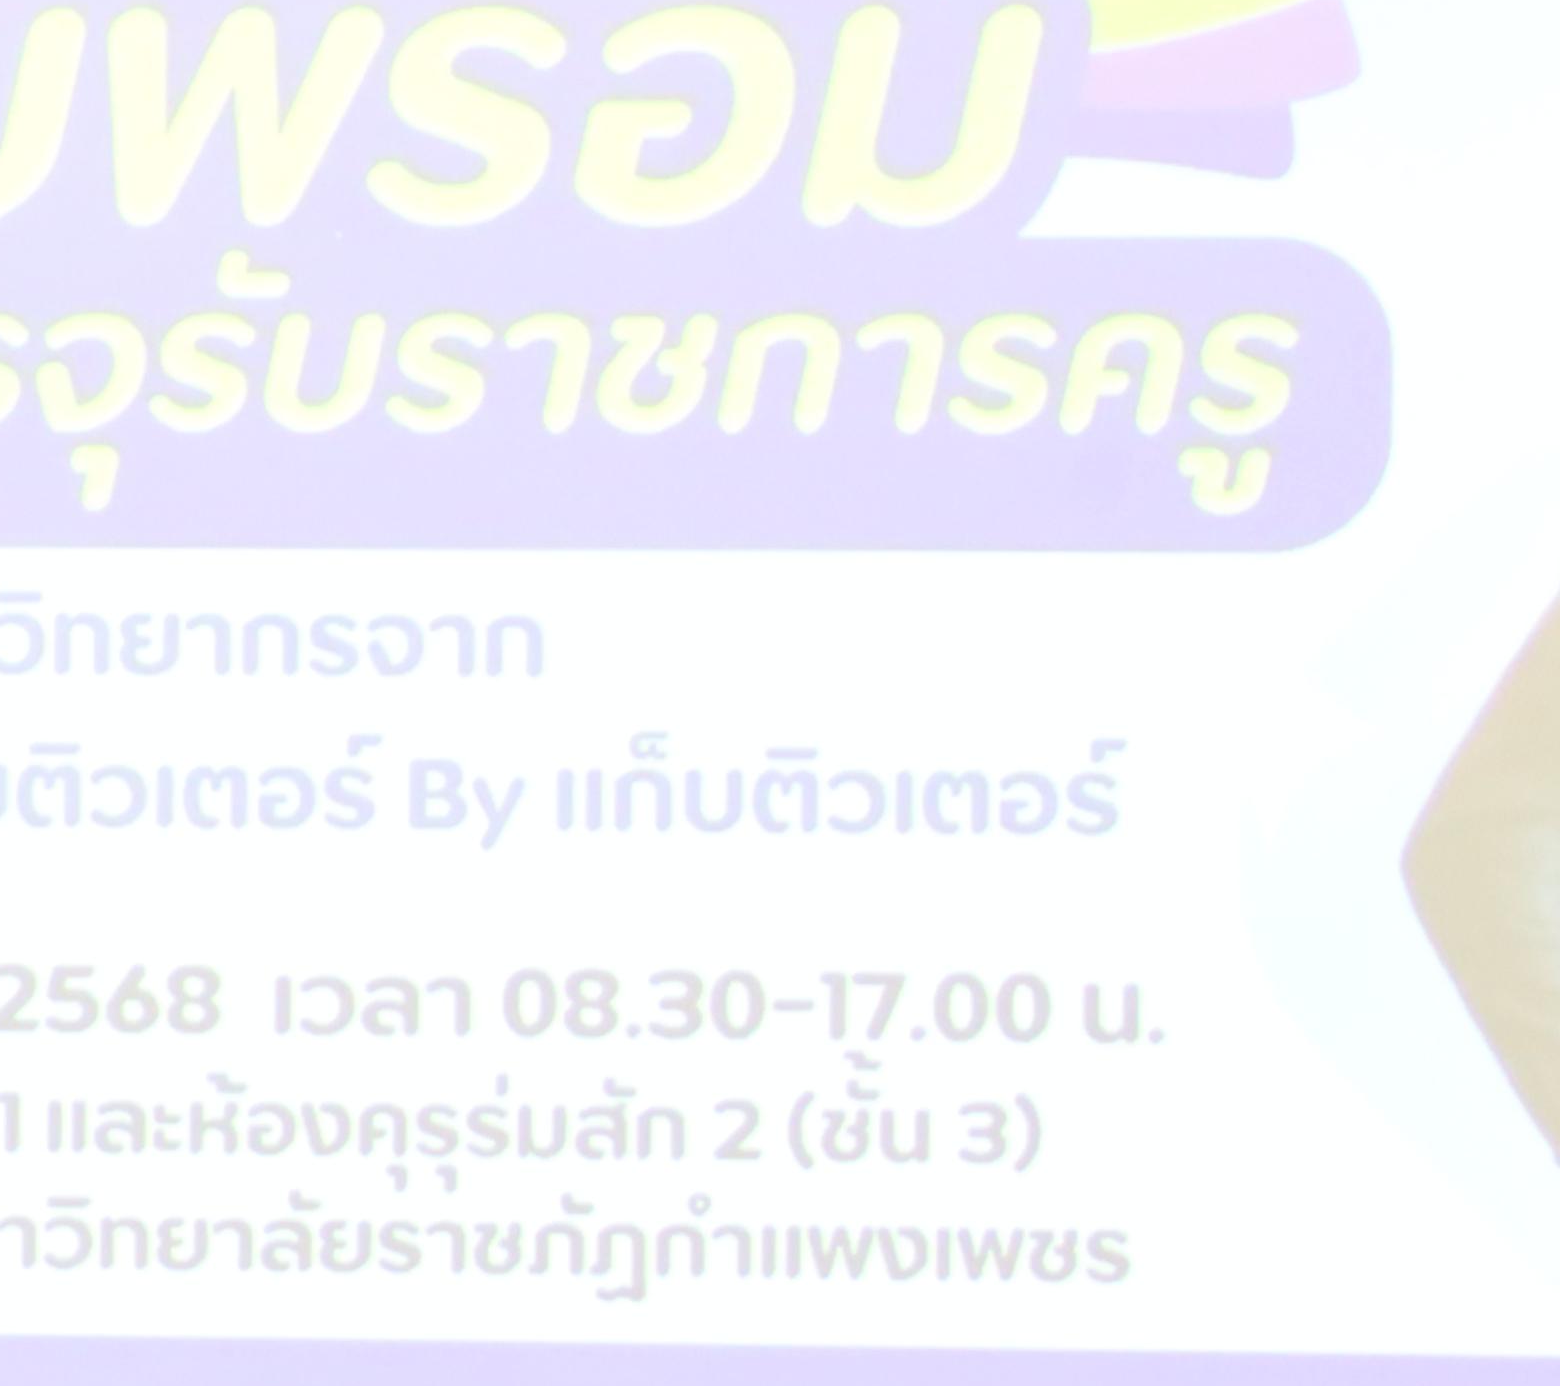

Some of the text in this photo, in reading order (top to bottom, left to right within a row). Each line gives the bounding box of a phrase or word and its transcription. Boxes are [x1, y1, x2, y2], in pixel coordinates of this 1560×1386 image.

[409, 759, 526, 850] By
[557, 731, 1128, 837] แก็บติวเตอร์
[275, 976, 472, 1037] เวลา
[1083, 983, 1166, 1045] น.
[714, 1100, 763, 1161] 2
[788, 1051, 931, 1170] (ชั้น
[959, 1093, 1043, 1173] 3)
